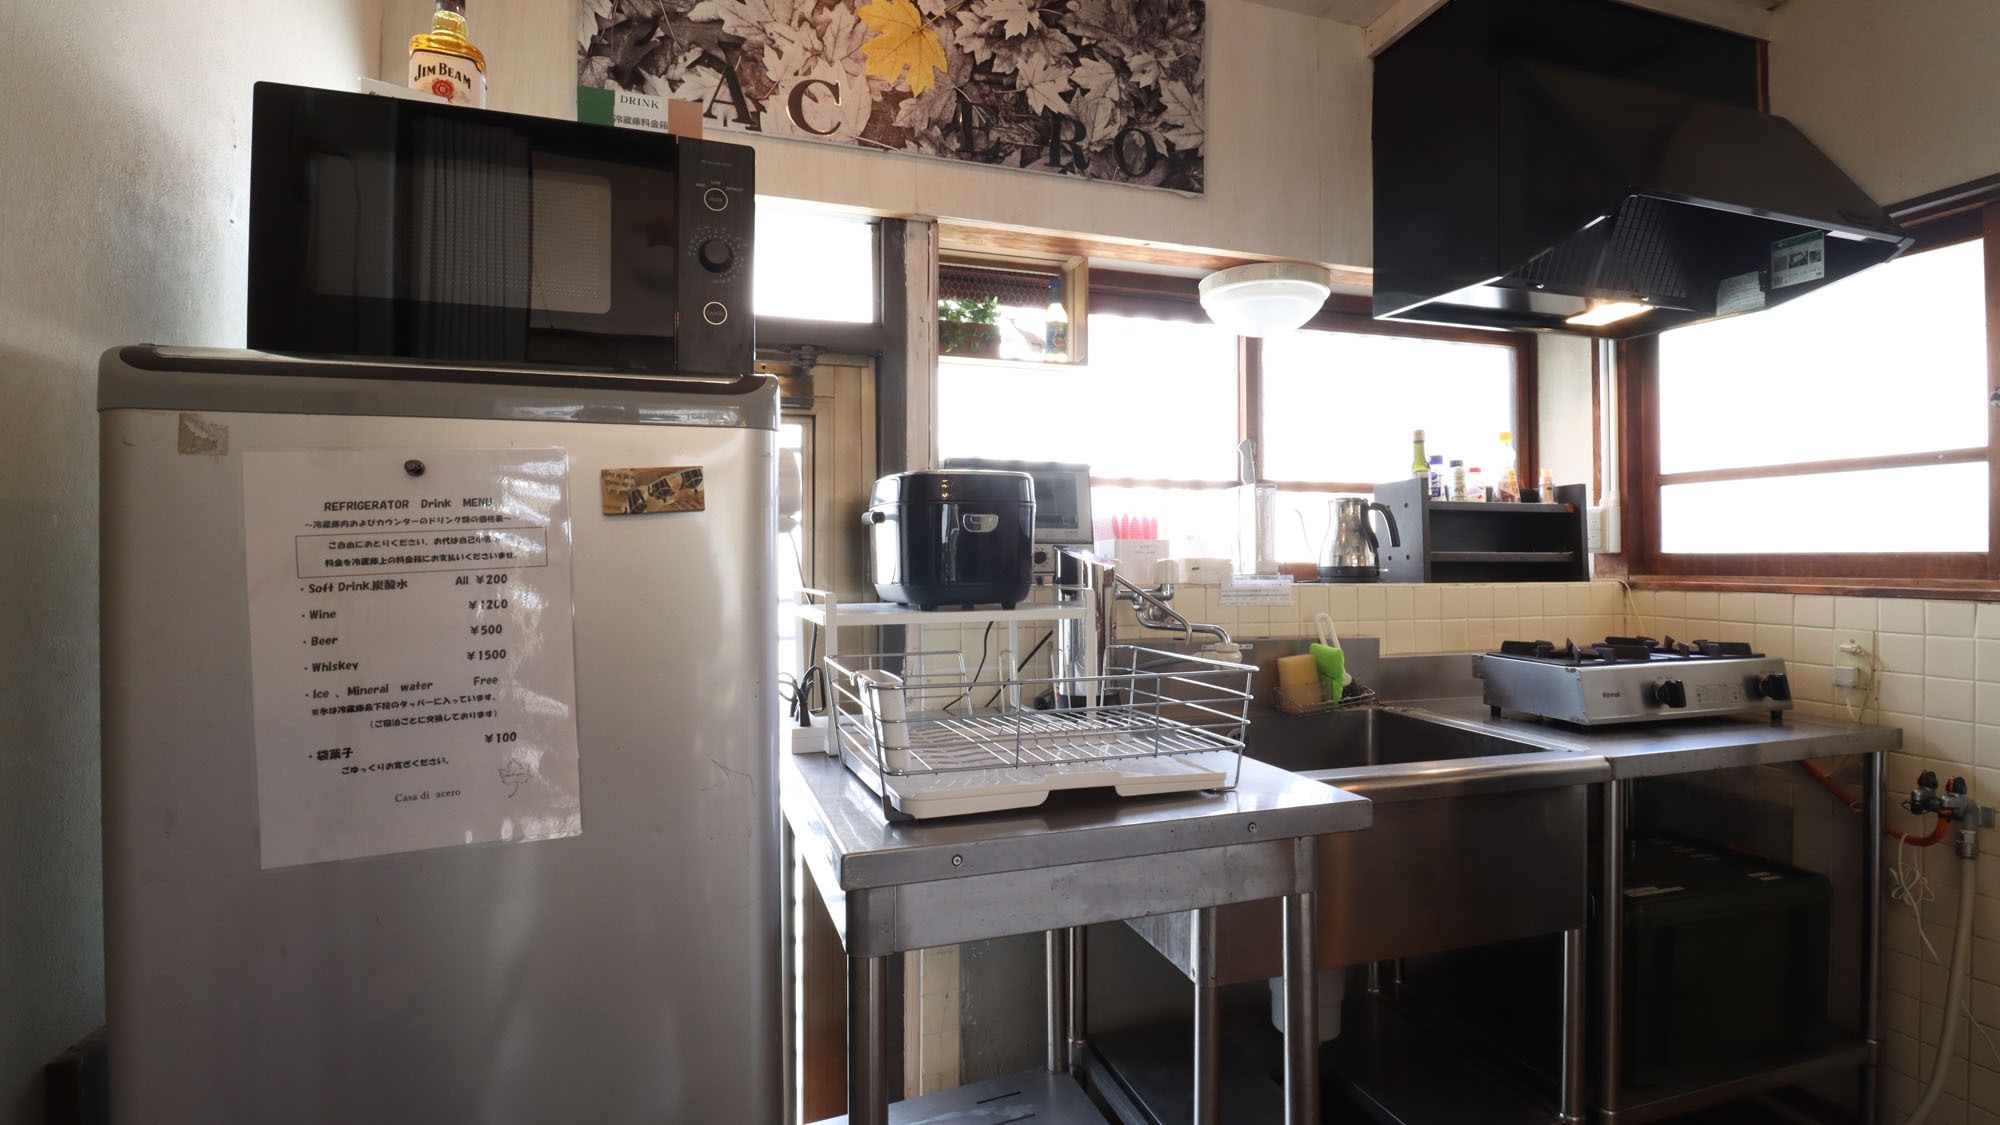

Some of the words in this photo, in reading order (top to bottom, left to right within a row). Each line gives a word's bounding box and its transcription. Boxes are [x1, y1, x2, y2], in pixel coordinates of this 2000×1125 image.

[414, 64, 436, 81] JIM
[439, 63, 471, 89] BEAM
[620, 95, 659, 109] DRINK
[324, 500, 409, 511] REFRIGERATOR
[421, 499, 451, 508] Drink
[463, 498, 492, 507] MENU
[309, 583, 333, 593] Soft
[456, 576, 468, 585] All
[476, 574, 507, 584] ¥200
[310, 610, 336, 619] Wine
[311, 637, 338, 646] Beer
[471, 624, 502, 635] ¥500
[312, 661, 358, 672] Whiskey
[467, 649, 506, 660] ¥1500
[348, 684, 388, 696] Mineral
[401, 682, 433, 691] water
[474, 676, 498, 685] Free
[485, 732, 516, 743] ¥100
[395, 794, 417, 802] Casa
[420, 791, 429, 799] di
[436, 790, 461, 798] acero
